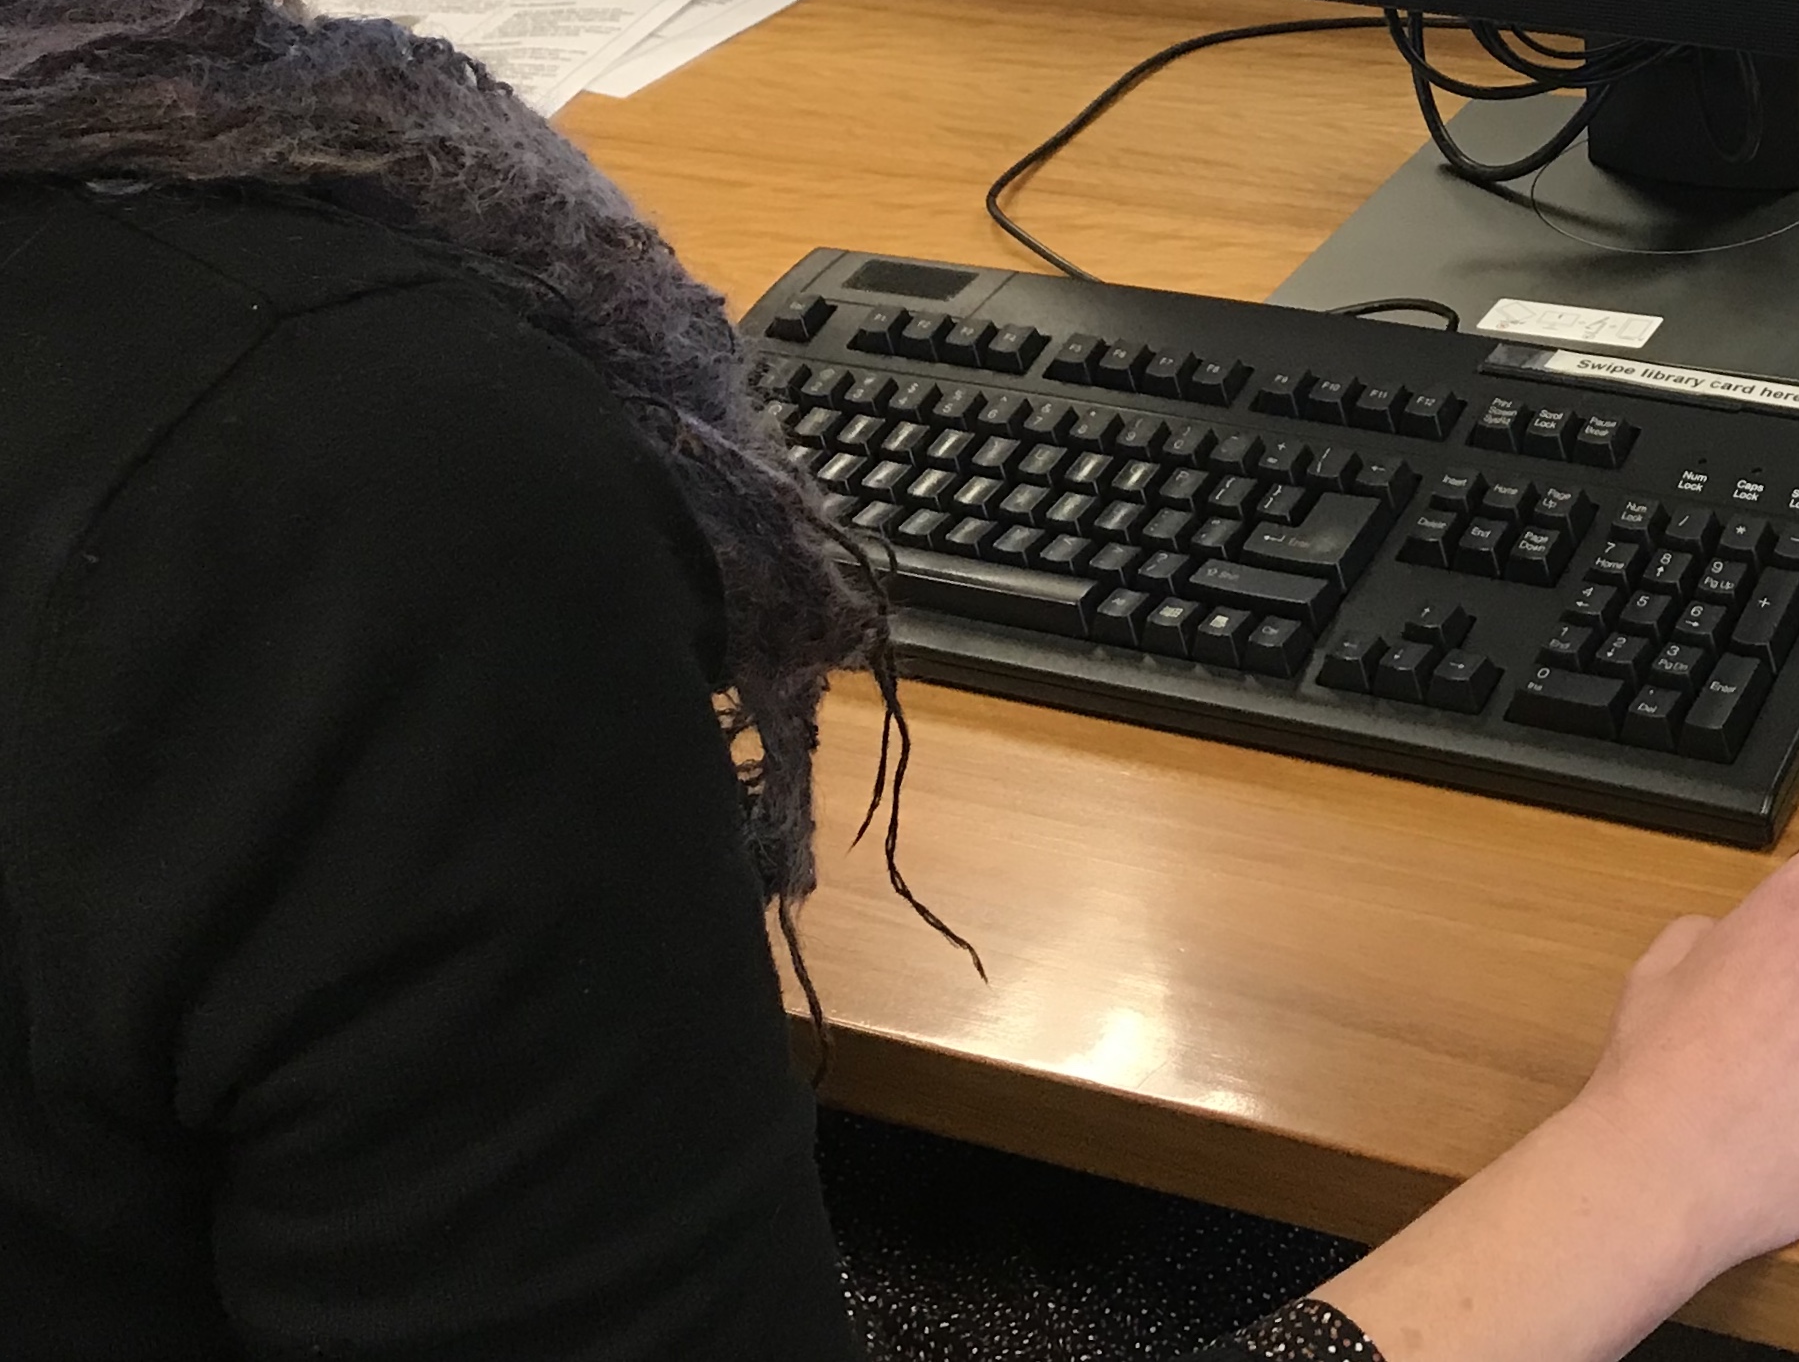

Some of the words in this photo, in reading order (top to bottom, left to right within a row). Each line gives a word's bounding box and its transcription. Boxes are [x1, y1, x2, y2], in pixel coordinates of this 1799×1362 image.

[1576, 358, 1635, 377] Swipe
[1640, 366, 1704, 389] library
[1709, 378, 1756, 395] card
[1321, 380, 1341, 392] F10
[1369, 389, 1388, 399] F11
[1416, 395, 1436, 406] F12
[1539, 409, 1563, 420] Scroll
[1534, 418, 1556, 429] Lock
[1589, 416, 1617, 427] Pause
[1442, 474, 1468, 486] Insert
[1682, 469, 1708, 483] Num
[1493, 484, 1519, 495] Home
[1678, 479, 1704, 492] Lock
[1737, 479, 1764, 494] Caps
[1547, 488, 1572, 501] Page
[1733, 489, 1759, 502] Lock
[1626, 502, 1648, 513] Num
[1621, 511, 1643, 522] Lock
[1471, 526, 1491, 539] End
[1524, 530, 1549, 544] Page
[1518, 540, 1545, 552] Down
[1604, 541, 1616, 553] 7
[1595, 556, 1625, 570] Home
[1660, 552, 1672, 565] 8
[1711, 561, 1724, 574] 9
[1703, 576, 1718, 589] Pg
[1720, 580, 1736, 590] Up
[1582, 586, 1594, 598] 4
[1636, 595, 1650, 607] 5
[1691, 605, 1704, 617] 6
[1613, 636, 1627, 648] 2
[1666, 645, 1680, 657] 3
[1537, 667, 1550, 679] 0
[1709, 680, 1737, 694] Enter
[1637, 702, 1657, 714] Del
